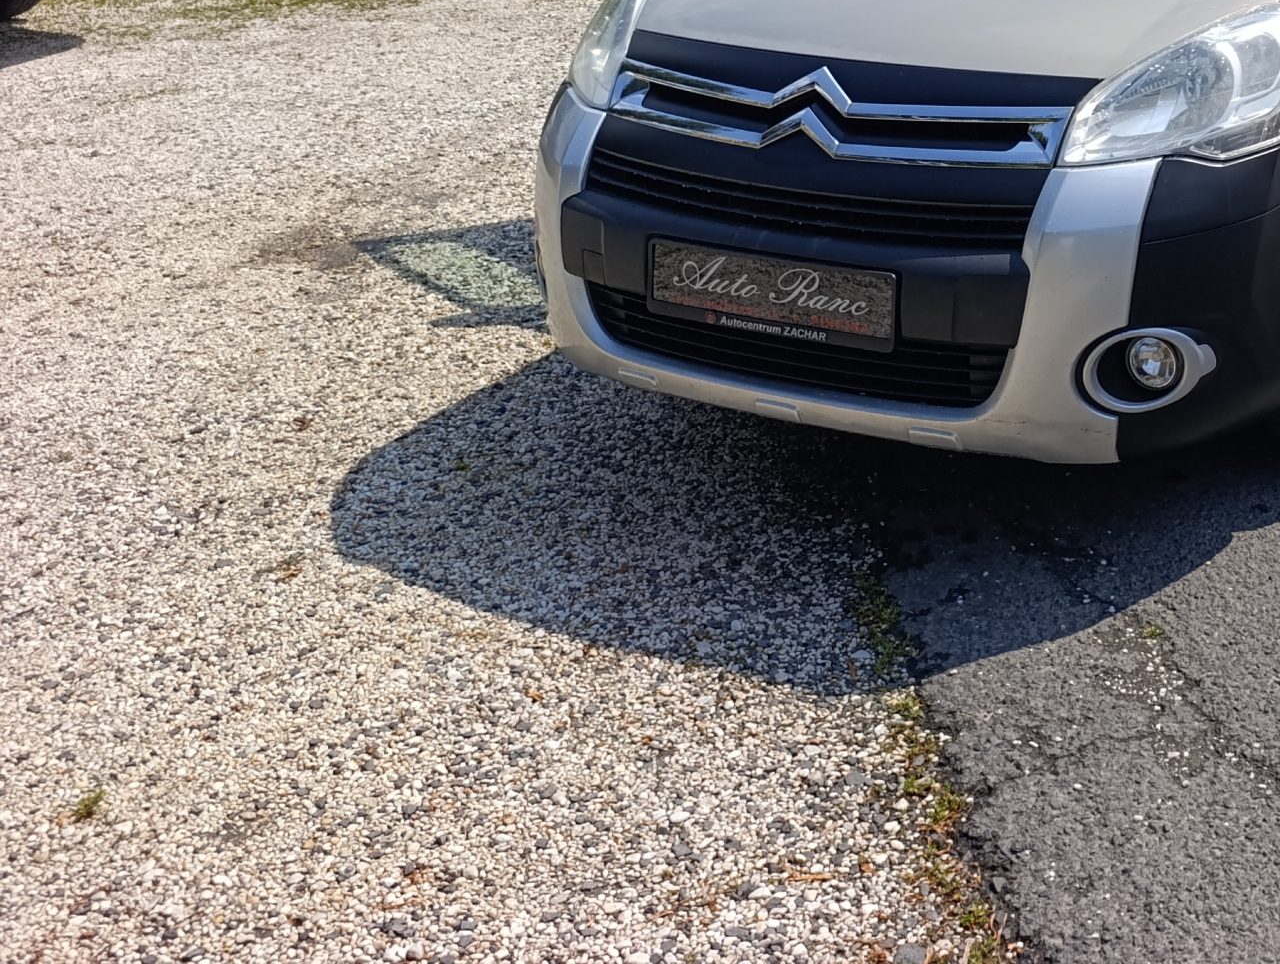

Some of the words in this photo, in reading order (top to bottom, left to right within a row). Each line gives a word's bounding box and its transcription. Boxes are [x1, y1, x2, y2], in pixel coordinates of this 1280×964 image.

[673, 256, 760, 298] Auto
[719, 315, 782, 335] Autocentrum
[783, 325, 827, 342] ZACHAR
